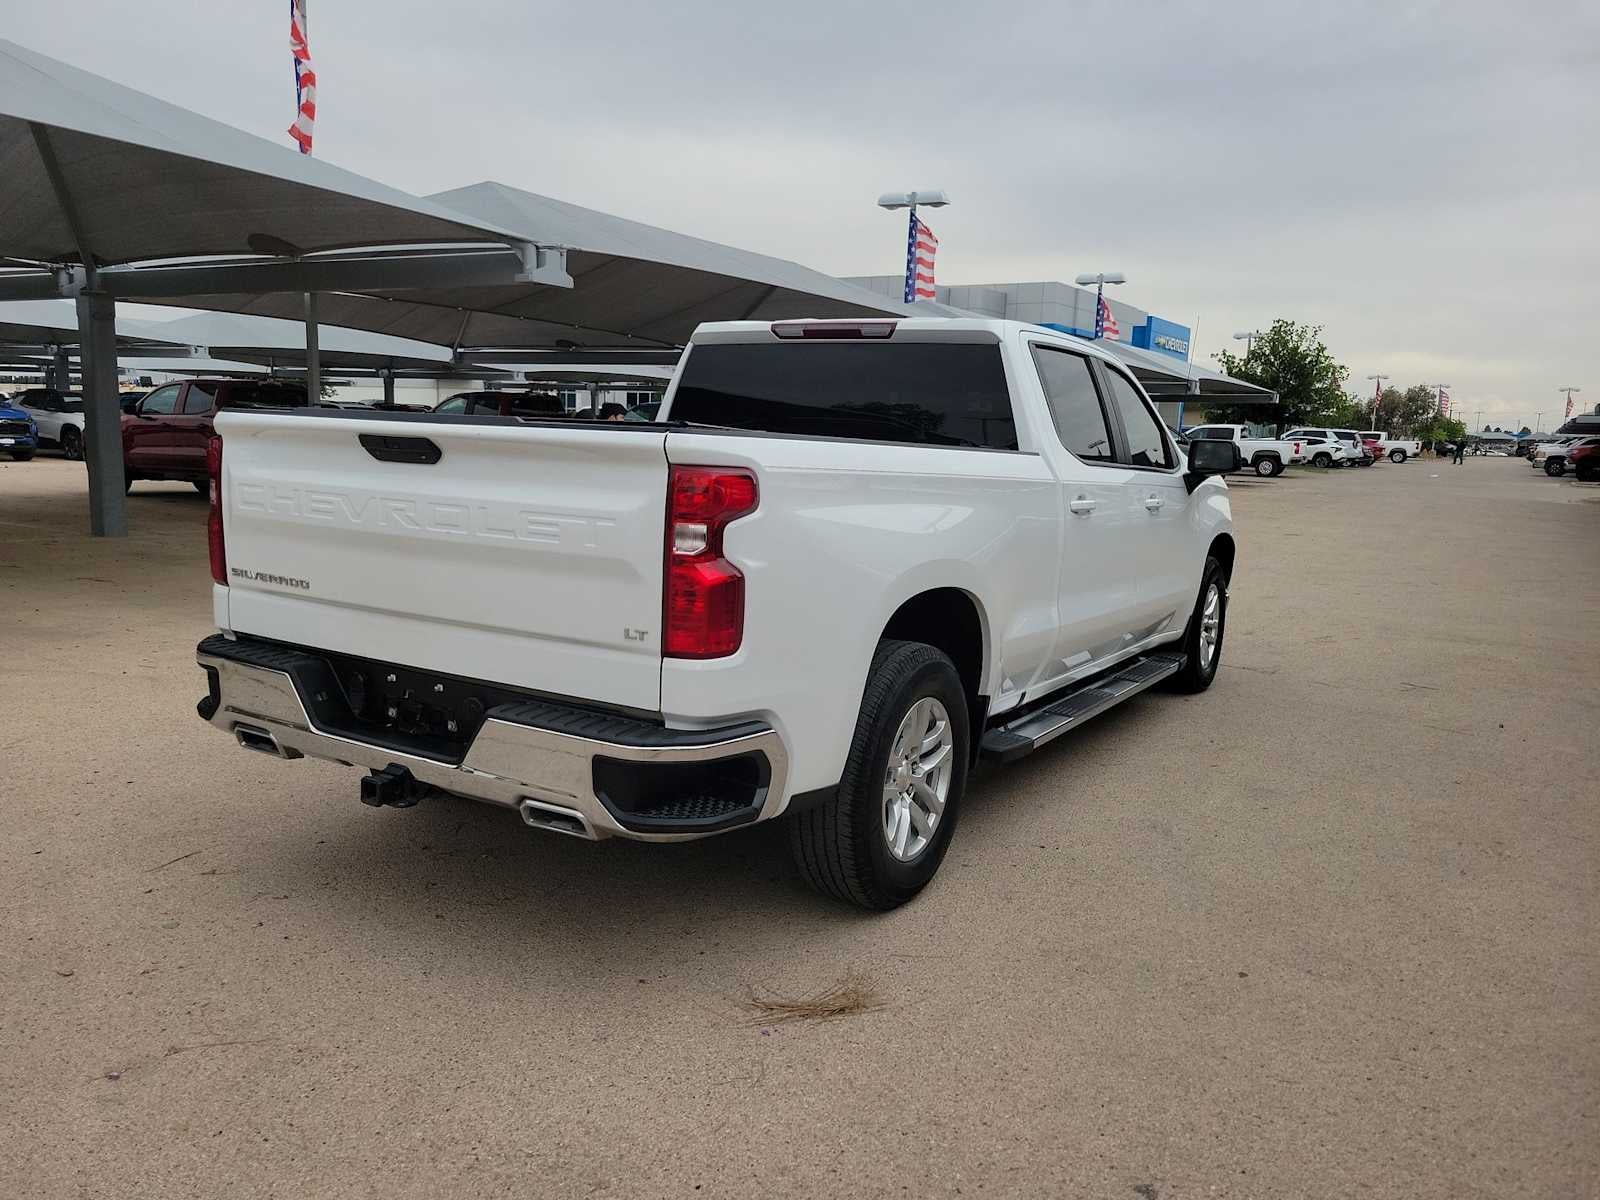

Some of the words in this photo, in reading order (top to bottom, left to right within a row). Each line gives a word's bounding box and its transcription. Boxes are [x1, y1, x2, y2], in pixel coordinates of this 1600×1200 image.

[235, 483, 616, 547] CHEVROLET
[231, 567, 310, 590] SILVERADO
[623, 627, 649, 642] LT
